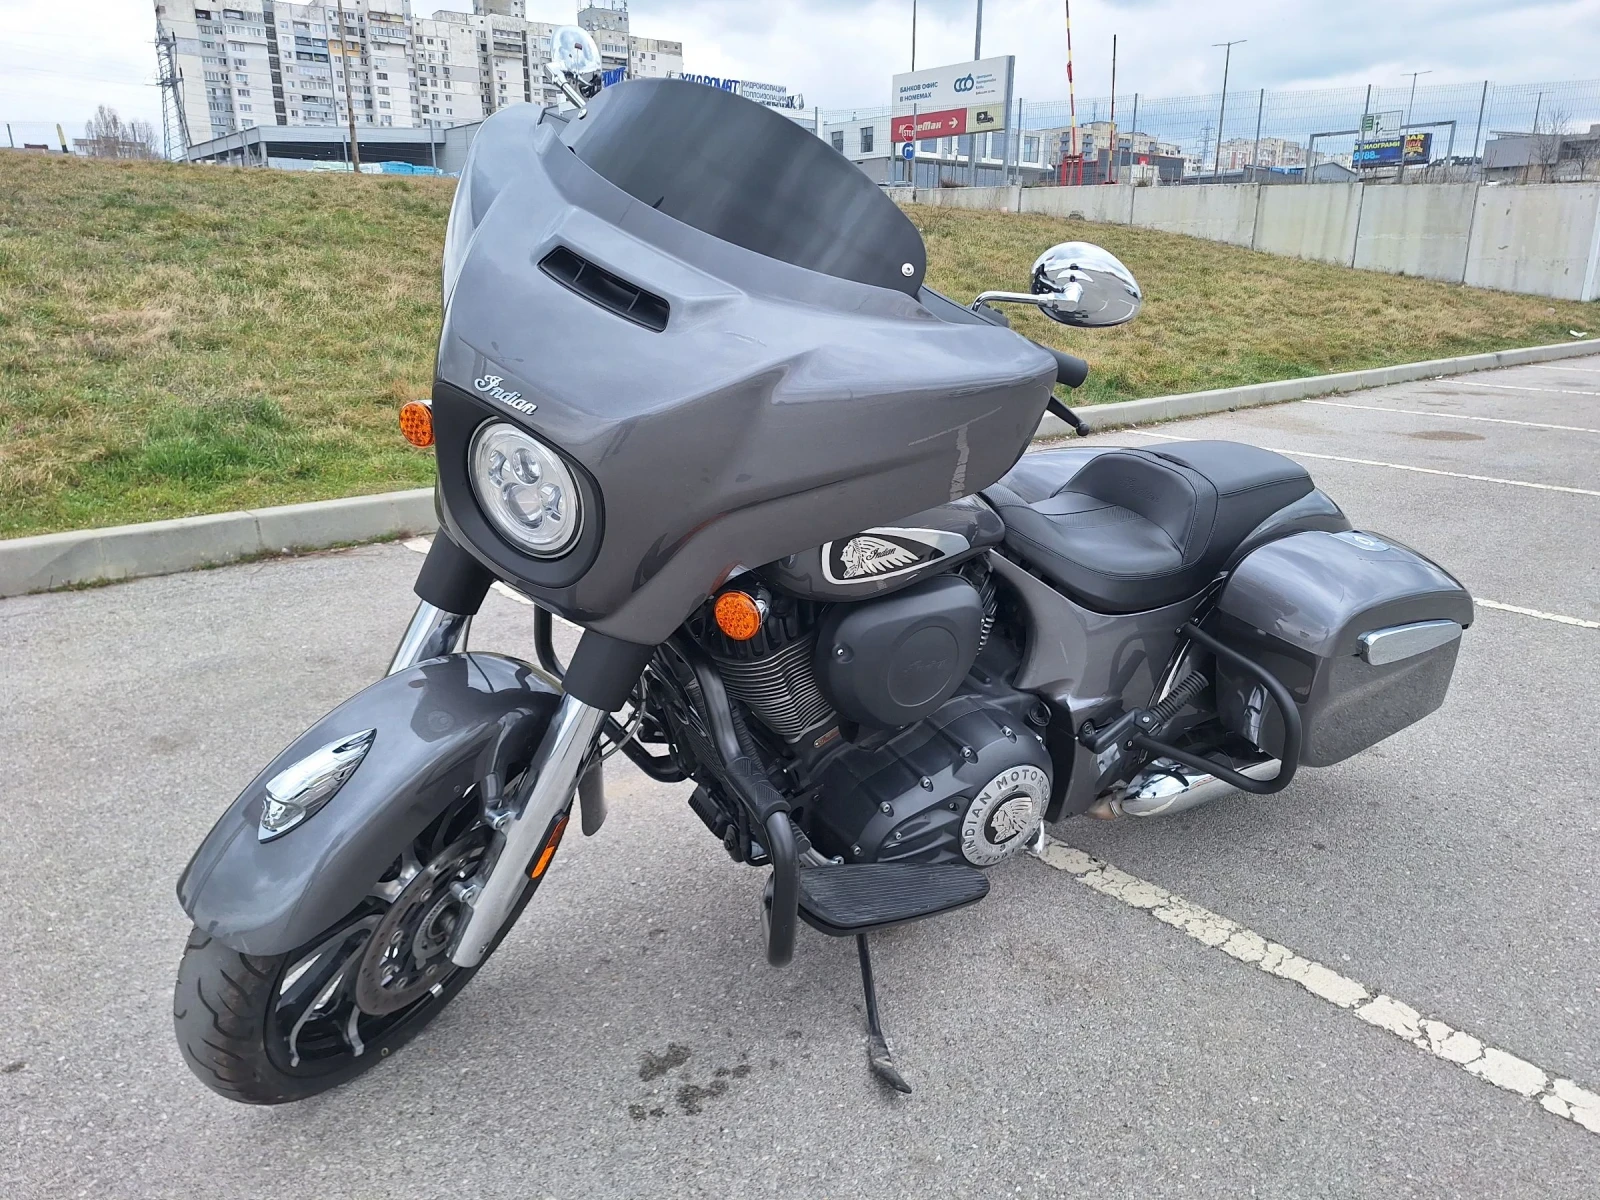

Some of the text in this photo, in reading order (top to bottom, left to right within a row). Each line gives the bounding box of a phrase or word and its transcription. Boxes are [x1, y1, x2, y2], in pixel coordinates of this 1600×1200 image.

[900, 81, 938, 93] БАНКОВ ОФИС
[475, 375, 537, 415] Indian
[866, 548, 896, 560] Indian
[965, 792, 992, 856] INDIAN
